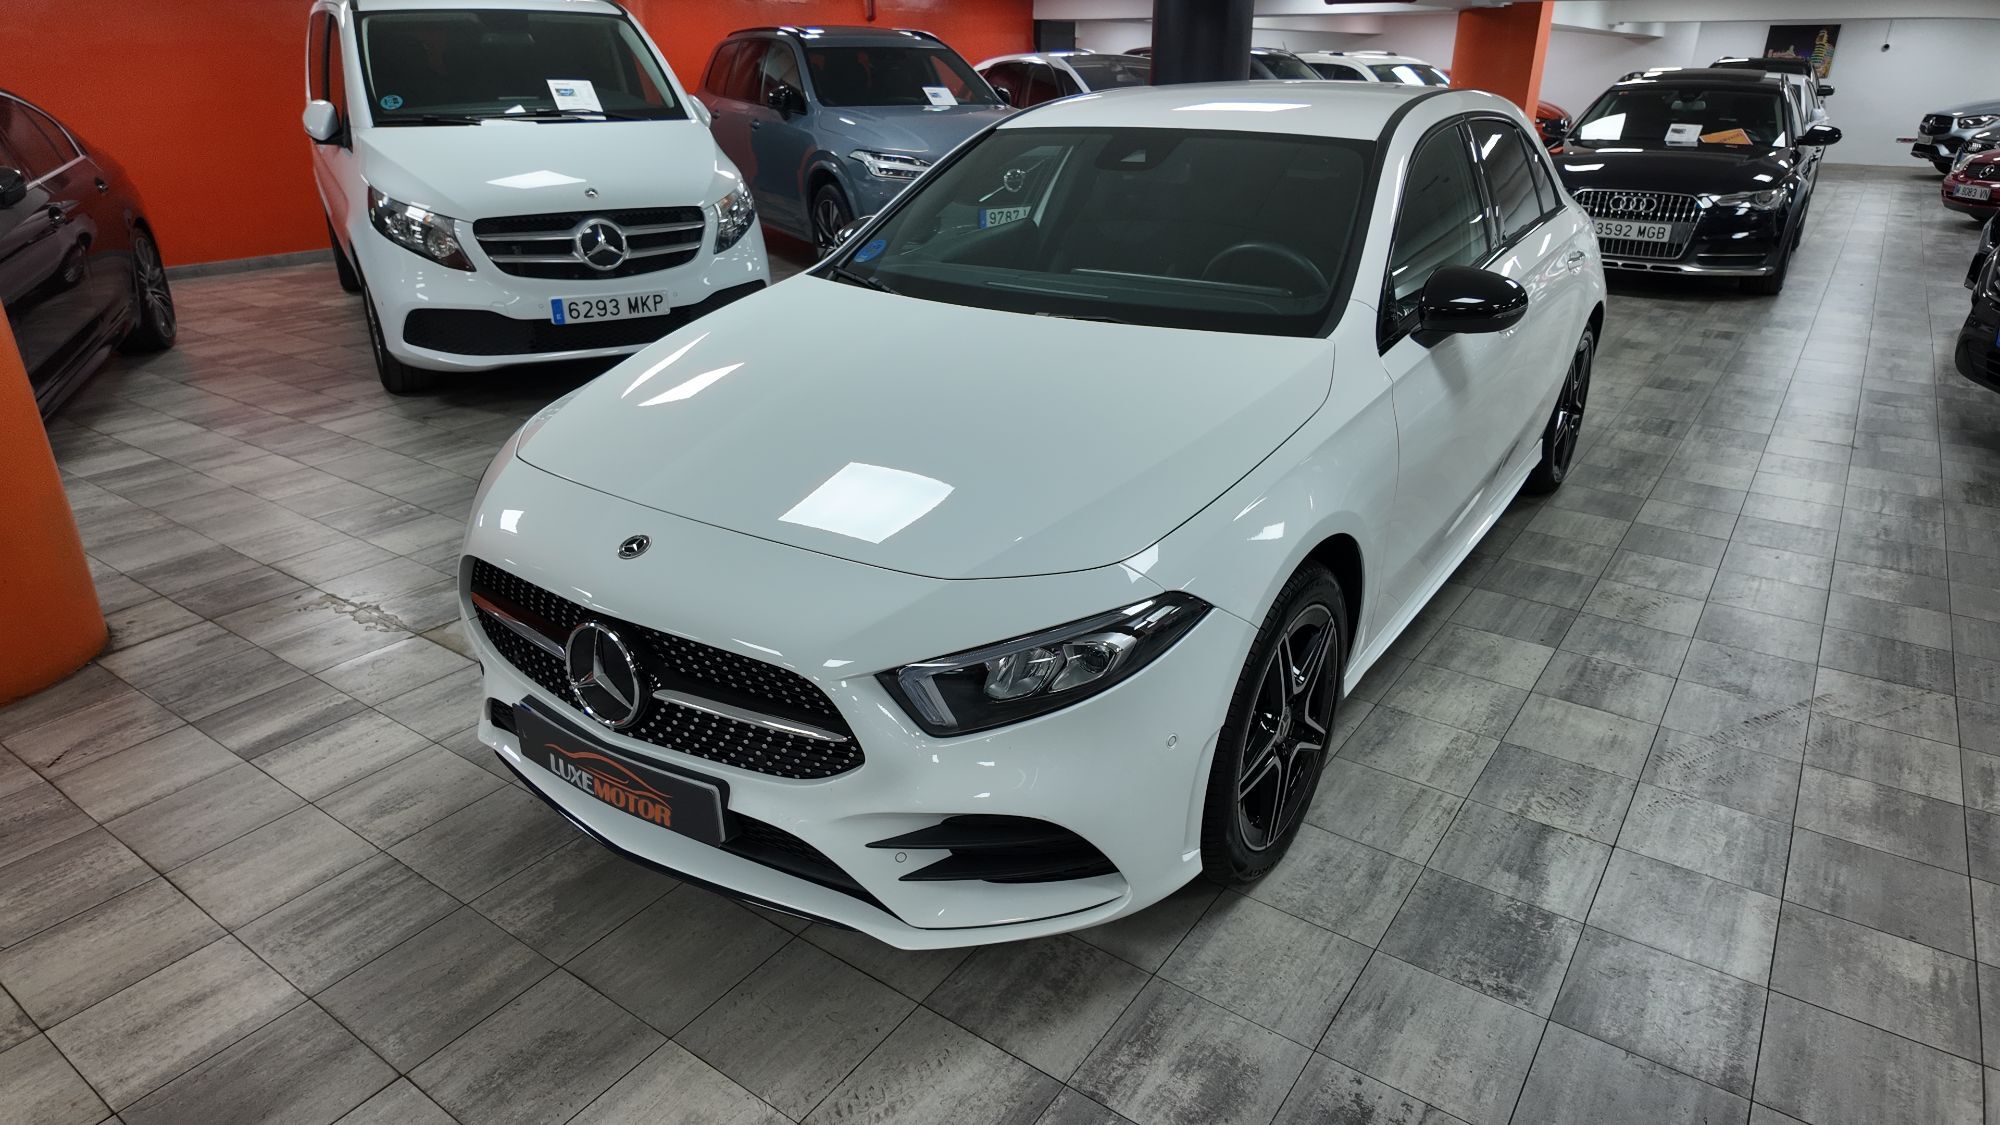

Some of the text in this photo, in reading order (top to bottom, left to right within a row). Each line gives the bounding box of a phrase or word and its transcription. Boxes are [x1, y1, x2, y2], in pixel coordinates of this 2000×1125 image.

[989, 210, 1020, 225] 9787
[1595, 222, 1666, 240] 3592 MGB
[568, 294, 664, 320] 6293 MKP
[549, 752, 672, 828] LUXEMOTOR
